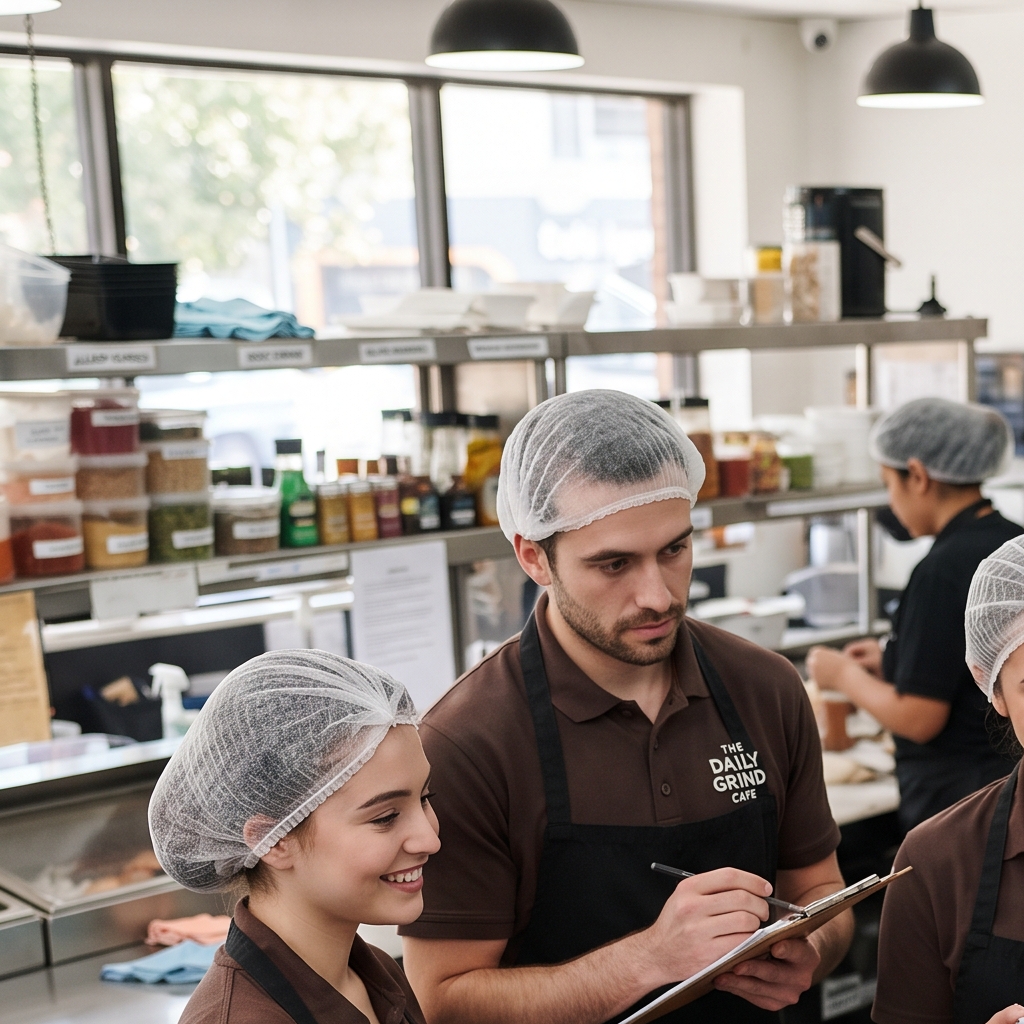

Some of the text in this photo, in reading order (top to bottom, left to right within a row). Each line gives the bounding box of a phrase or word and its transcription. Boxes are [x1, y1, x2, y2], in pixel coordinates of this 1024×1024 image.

[720, 742, 744, 754] THE
[708, 751, 758, 774] DAILY
[713, 769, 766, 792] GRIND
[731, 789, 757, 803] CAFE
